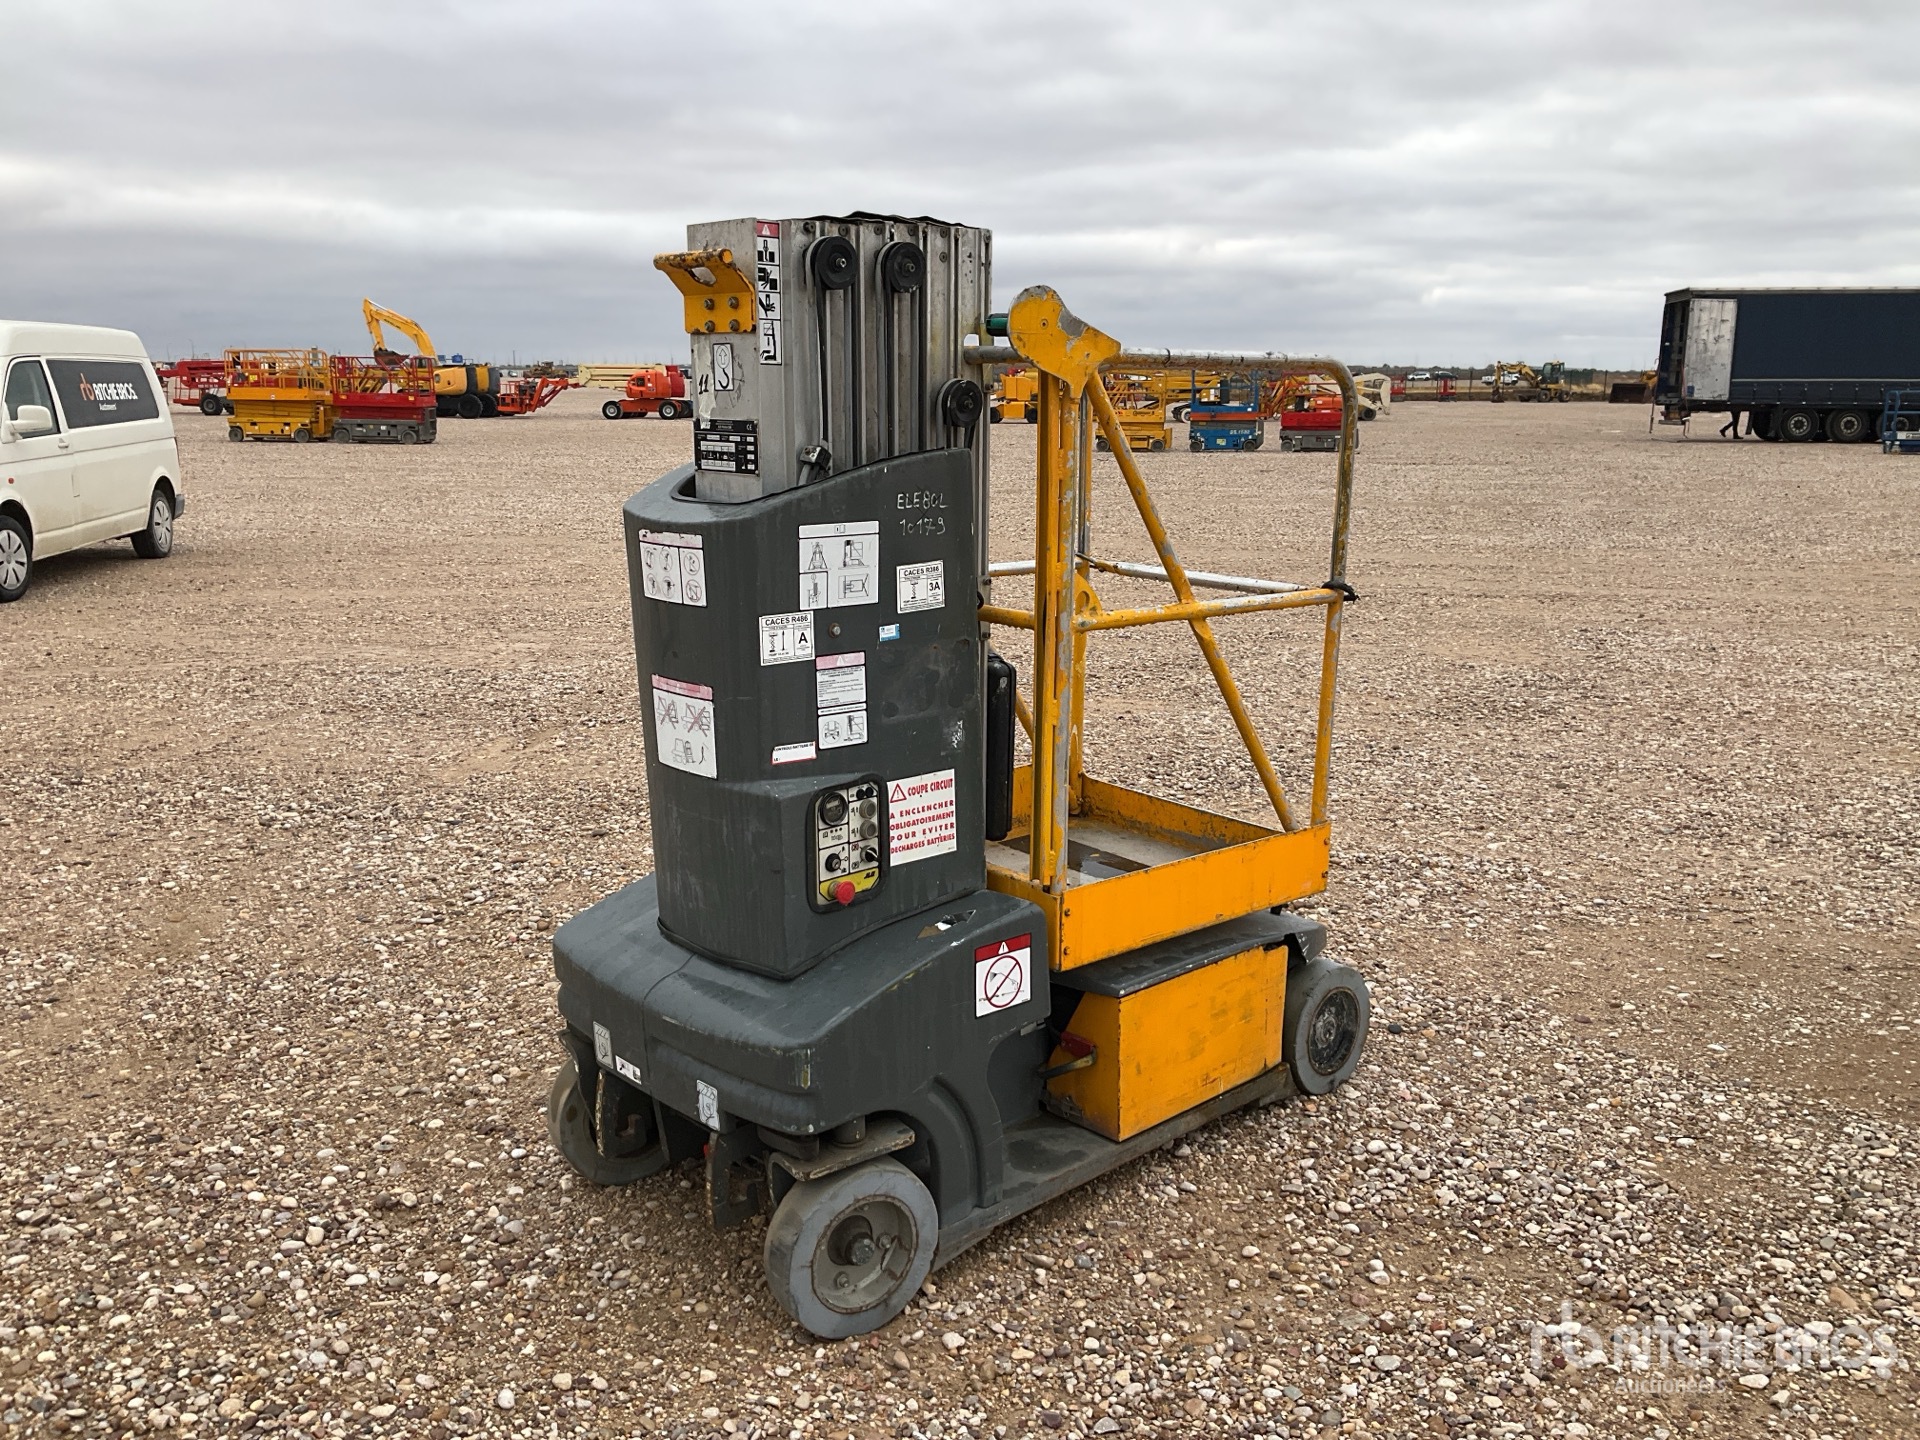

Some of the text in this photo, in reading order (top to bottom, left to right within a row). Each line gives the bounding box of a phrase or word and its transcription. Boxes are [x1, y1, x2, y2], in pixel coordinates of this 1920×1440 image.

[92, 382, 119, 400] RITCHIE
[903, 569, 925, 577] CACES
[929, 581, 941, 592] 3A
[765, 614, 809, 626] CACES R486
[798, 631, 809, 644] A
[907, 778, 954, 797] COUPE CIRCUIT
[889, 799, 954, 820] A ENCLENCHER
[889, 810, 955, 831] OBLIGATOIREMENT
[890, 822, 955, 843] POUR EVITER
[890, 832, 955, 854] DECHARGES BATTERIES
